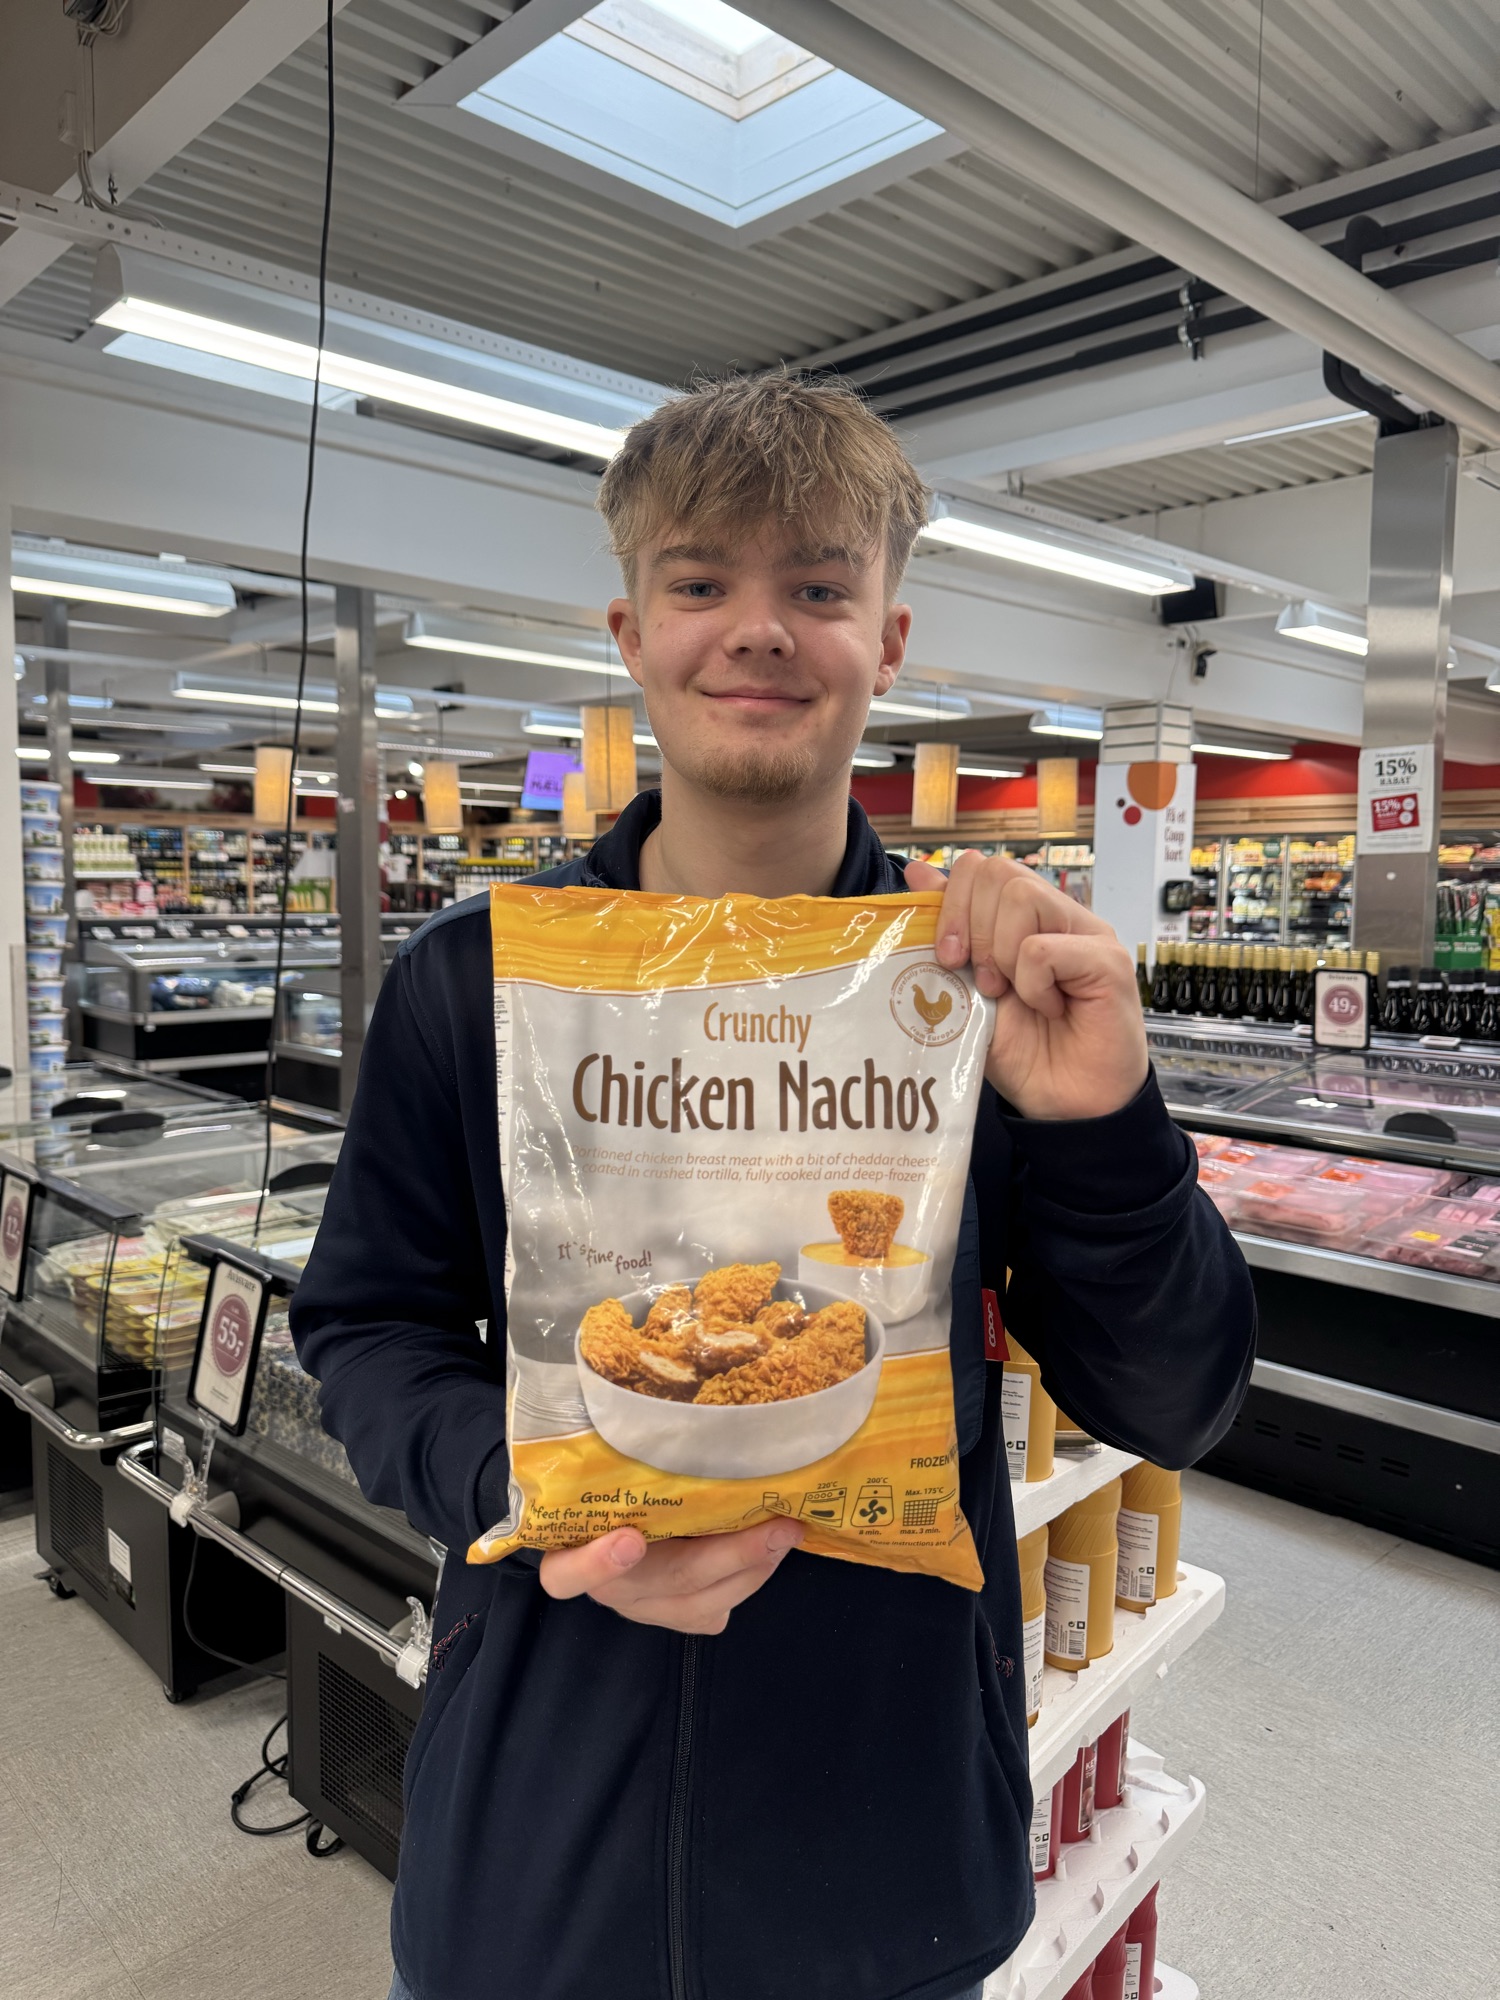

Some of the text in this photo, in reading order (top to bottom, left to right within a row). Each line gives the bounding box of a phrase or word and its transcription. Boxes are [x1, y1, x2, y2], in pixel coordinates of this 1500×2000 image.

[1374, 758, 1417, 777] 15%
[897, 966, 965, 999] carefully selected chicken
[704, 1002, 812, 1053] Crunchy
[927, 1028, 955, 1041] Europe
[573, 1053, 755, 1133] Chicken
[779, 1058, 939, 1134] Nachos
[572, 1145, 632, 1161] Portioned
[635, 1151, 682, 1165] chicken
[686, 1152, 726, 1166] breast
[729, 1154, 761, 1166] meat
[764, 1153, 792, 1166] with
[795, 1157, 804, 1166] a
[807, 1153, 824, 1166] bit
[827, 1152, 841, 1166] of
[843, 1153, 894, 1166] cheddar
[582, 1161, 626, 1176] coated
[628, 1165, 639, 1178] in
[643, 1167, 693, 1180] crushed
[696, 1168, 742, 1183] tortilla,
[745, 1168, 773, 1184] fully
[775, 1168, 821, 1182] cooked
[824, 1168, 850, 1181] and
[586, 1248, 613, 1268] fine
[615, 1249, 652, 1274] food!
[910, 1455, 950, 1469] FROZEN
[818, 1481, 838, 1489] 220°C
[924, 1487, 944, 1495] 175°C
[580, 1488, 683, 1507] Good to know
[563, 1508, 582, 1520] for
[586, 1509, 609, 1523] any
[613, 1510, 647, 1519] menu
[536, 1520, 589, 1533] artificial
[517, 1531, 549, 1542] Made
